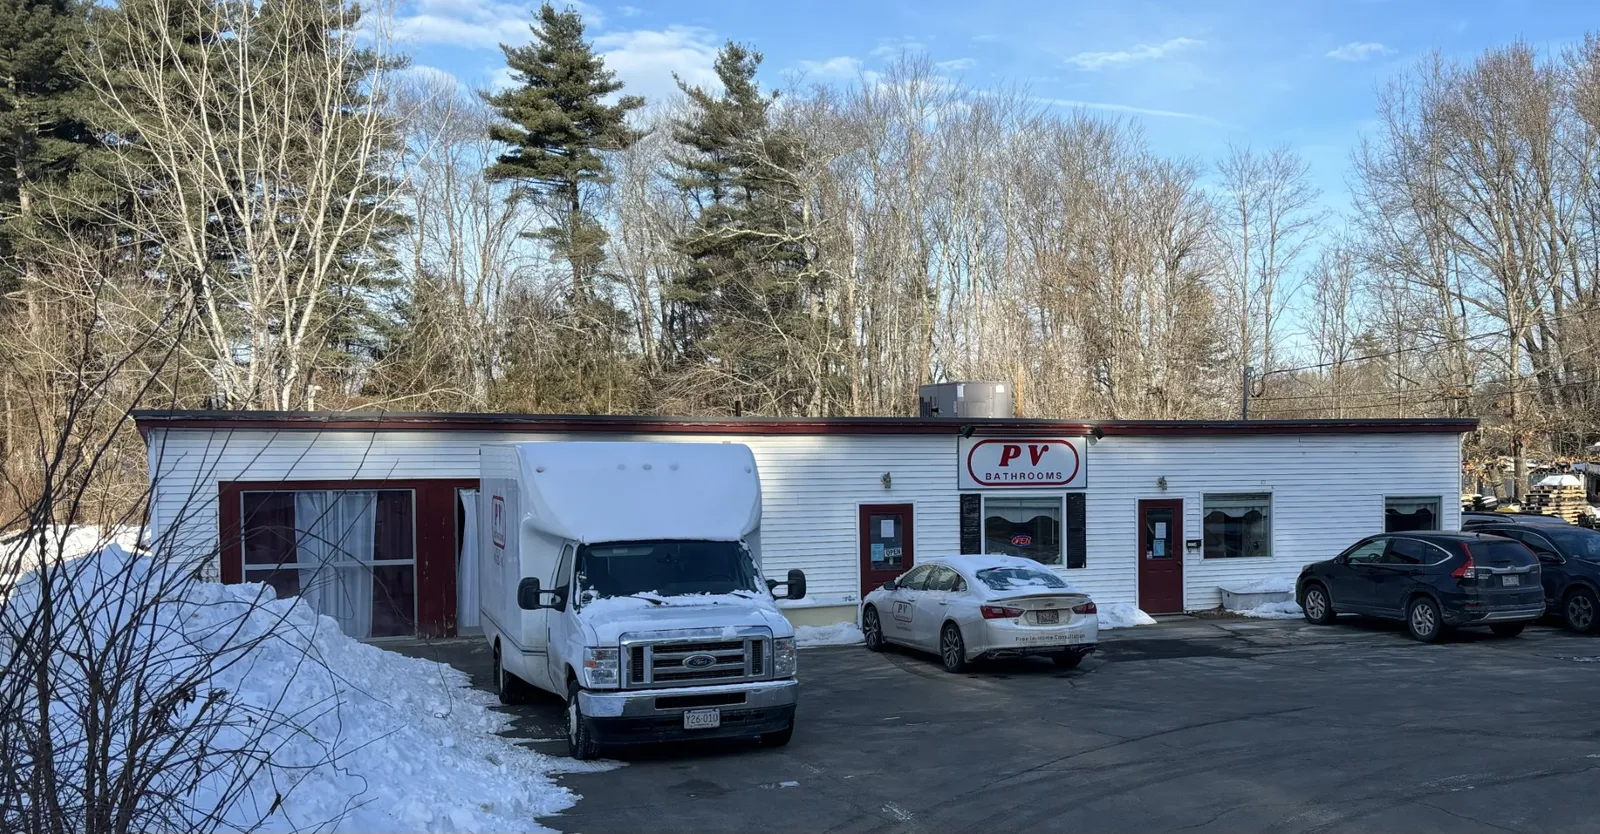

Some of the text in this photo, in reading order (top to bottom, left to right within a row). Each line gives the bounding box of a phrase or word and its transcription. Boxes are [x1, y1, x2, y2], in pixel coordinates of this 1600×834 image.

[999, 445, 1049, 467] PV
[985, 472, 1062, 480] BATHROOMS
[1011, 537, 1031, 545] OPEN
